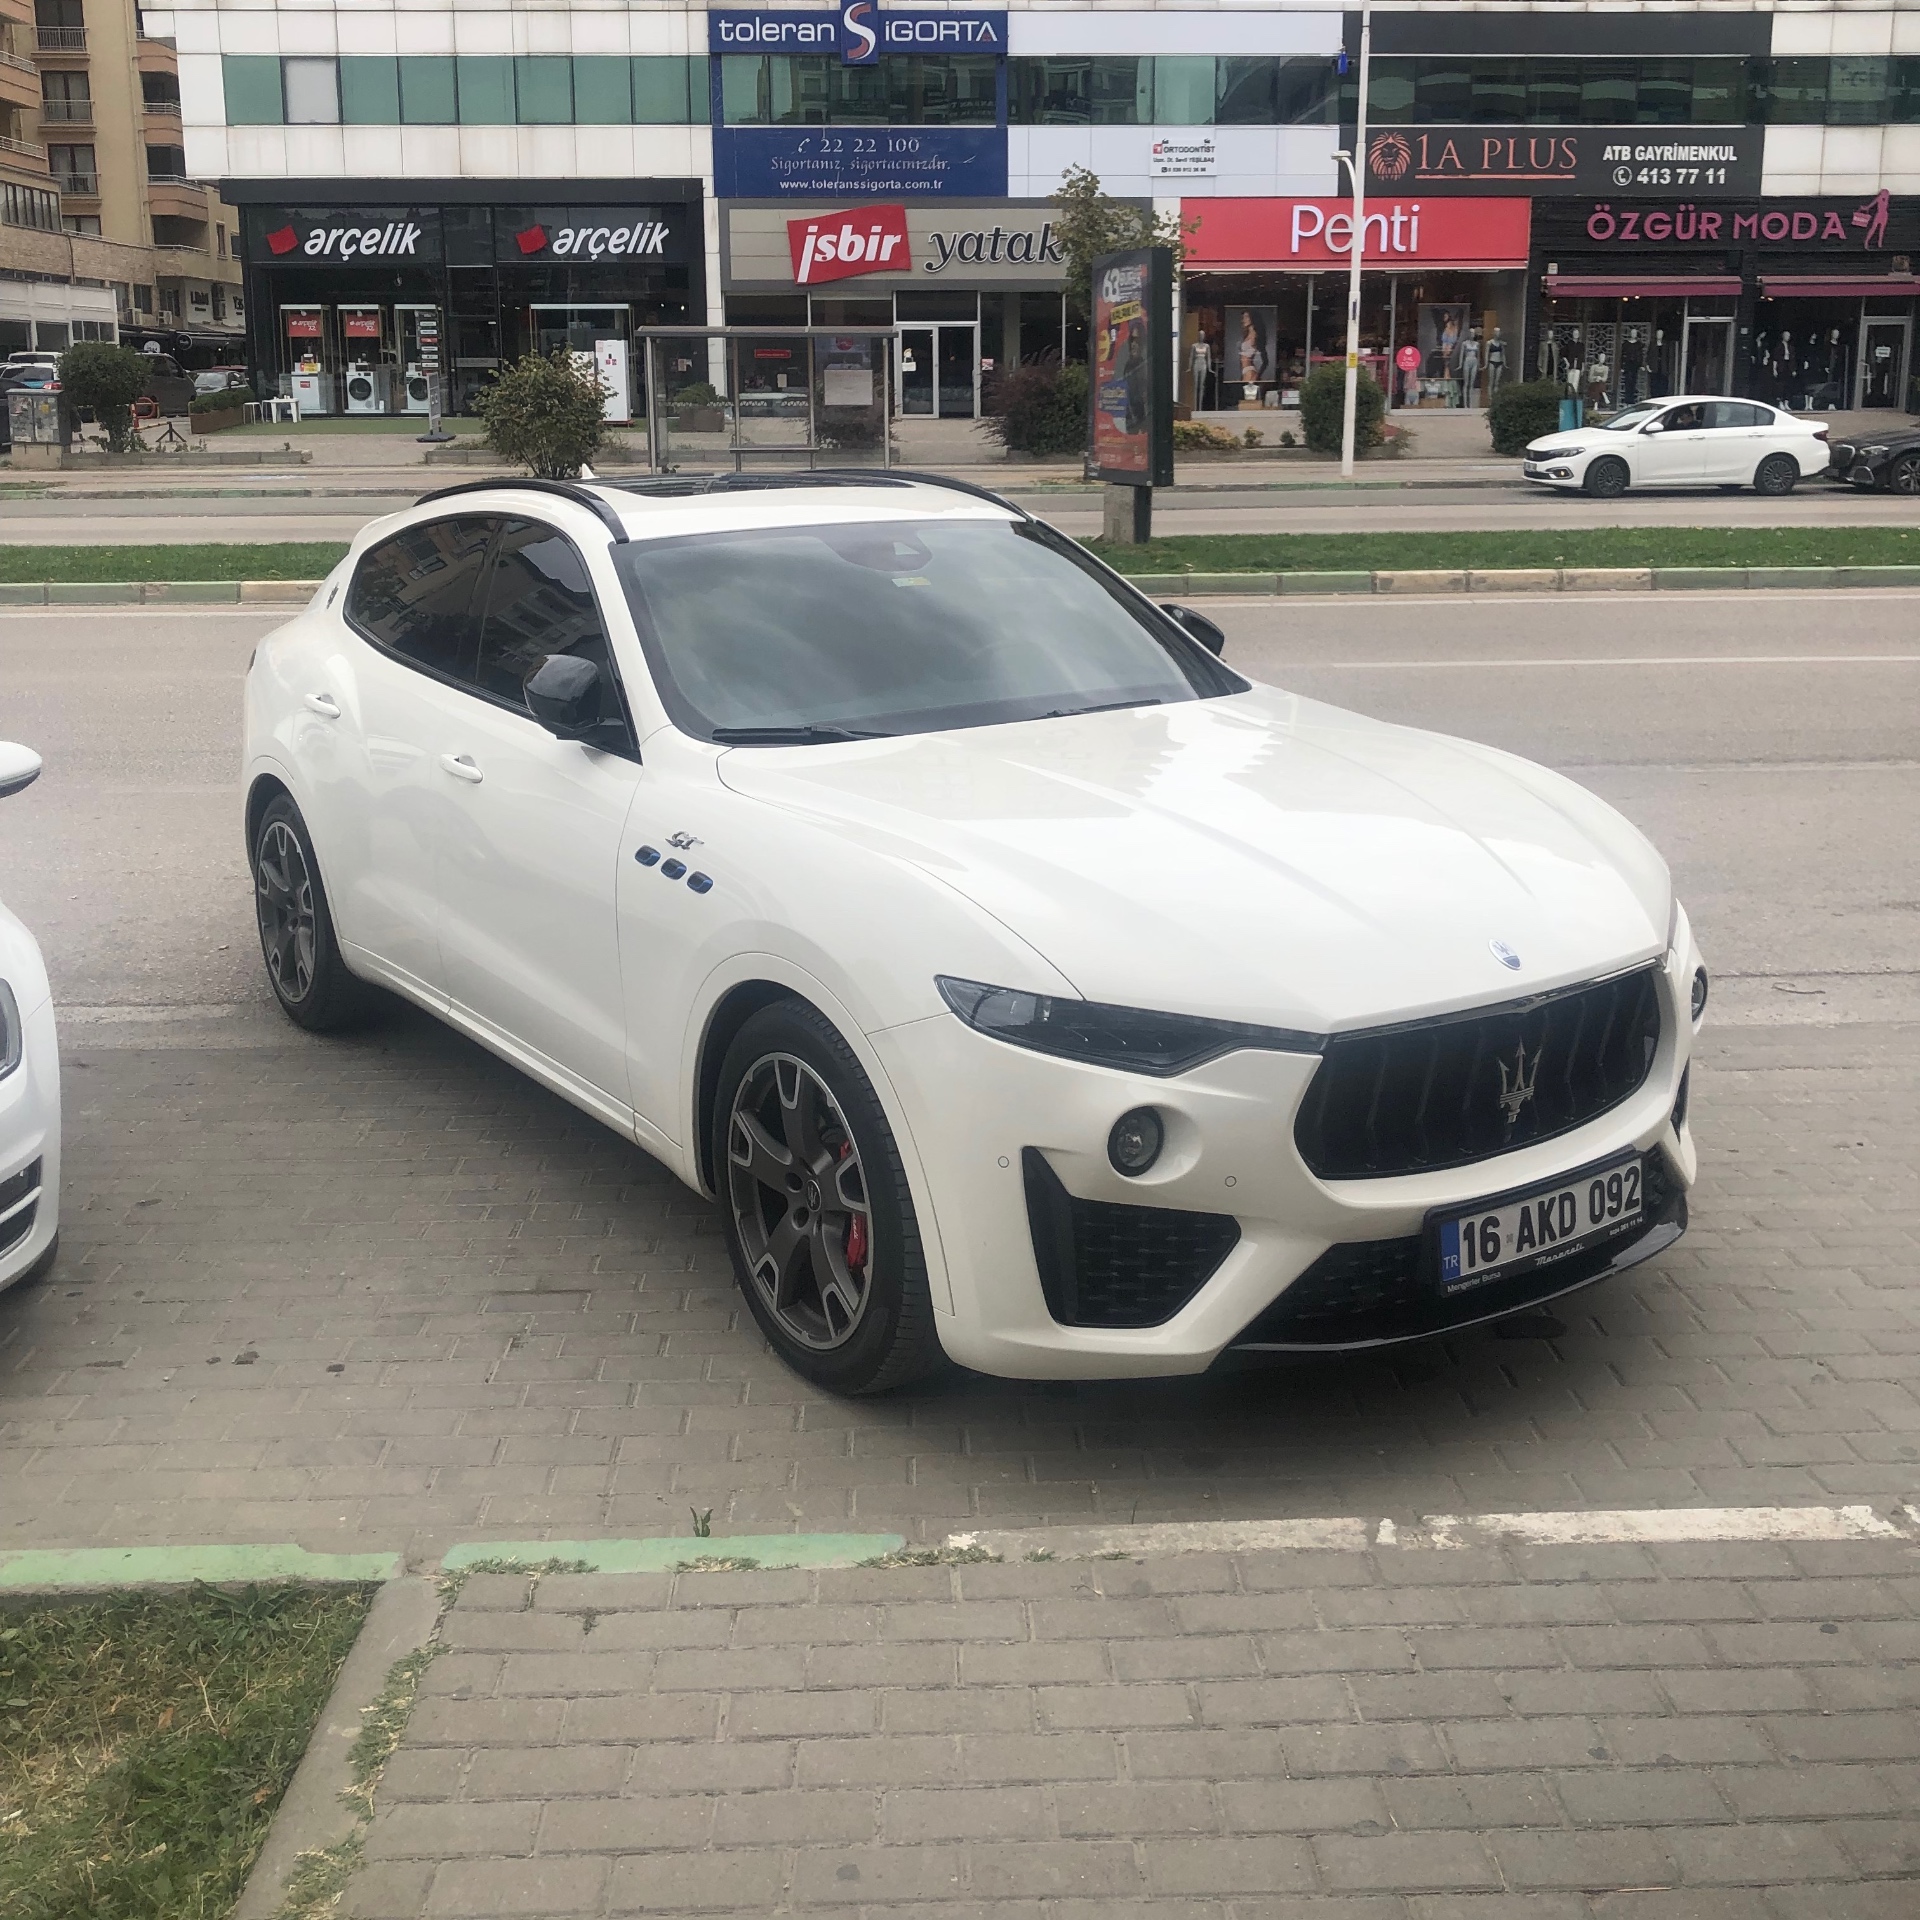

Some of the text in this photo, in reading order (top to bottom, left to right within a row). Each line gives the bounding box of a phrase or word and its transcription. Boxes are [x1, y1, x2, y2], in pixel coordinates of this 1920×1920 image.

[719, 16, 835, 42] toleran
[820, 138, 920, 153] 22 22 100
[1416, 133, 1578, 170] 1A PLUS
[1602, 141, 1738, 161] ATB GAYRİMENKUL
[780, 179, 943, 191] www.toleranssigorta.com.tr
[1636, 167, 1727, 185] 413 77 11
[1291, 204, 1421, 253] Penti
[1587, 204, 1847, 240] ÖZGÜR MODA
[303, 222, 422, 261] arçelik
[552, 222, 670, 261] arçelik
[923, 221, 1066, 273] yatak
[1443, 1165, 1641, 1270] TR 16 AKD 092
[1534, 1242, 1585, 1266] Maserati
